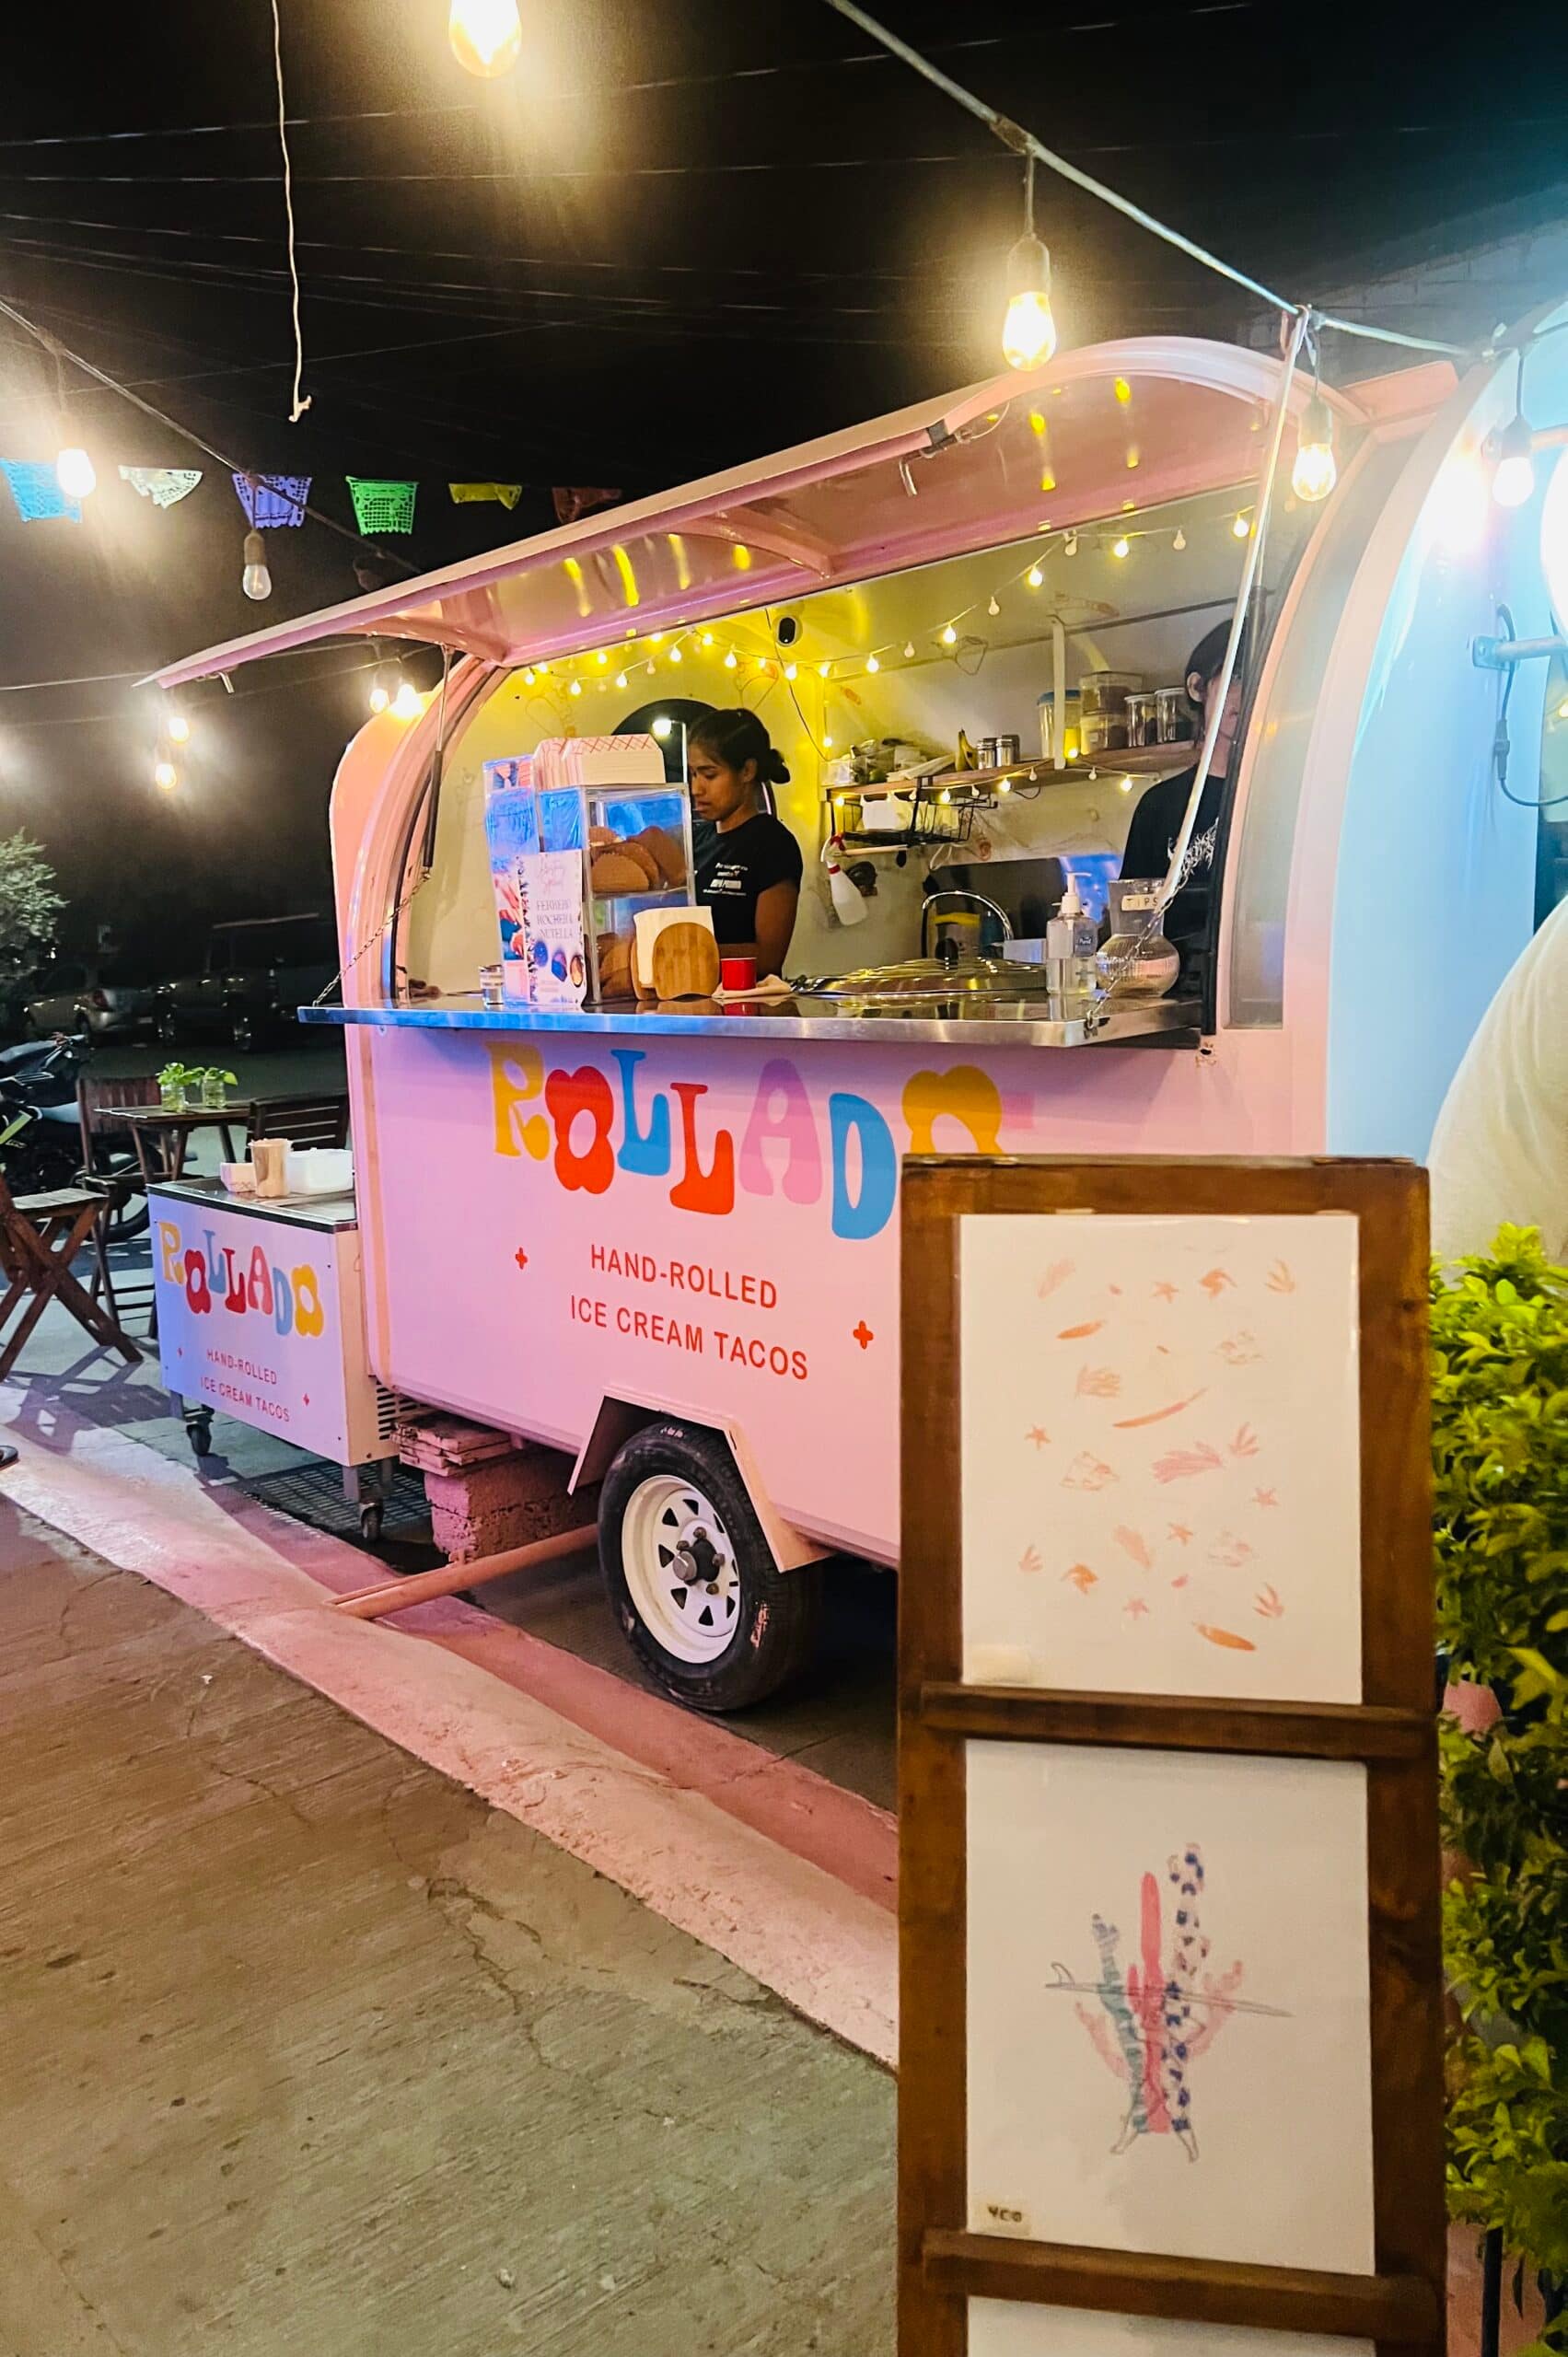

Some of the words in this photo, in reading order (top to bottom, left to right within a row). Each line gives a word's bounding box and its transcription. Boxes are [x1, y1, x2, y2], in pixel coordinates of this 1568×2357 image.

[1126, 897, 1158, 907] TIPS
[158, 1222, 324, 1337] ROLLADO
[591, 1244, 777, 1308] HAND-ROLLED
[571, 1295, 608, 1328] ICE
[617, 1307, 703, 1353] CREAM
[714, 1330, 808, 1380] TACOS
[206, 1349, 277, 1385] HAND-ROLLED
[200, 1376, 216, 1392] ICE
[219, 1383, 252, 1407] CREAM
[256, 1396, 290, 1422] TACOS
